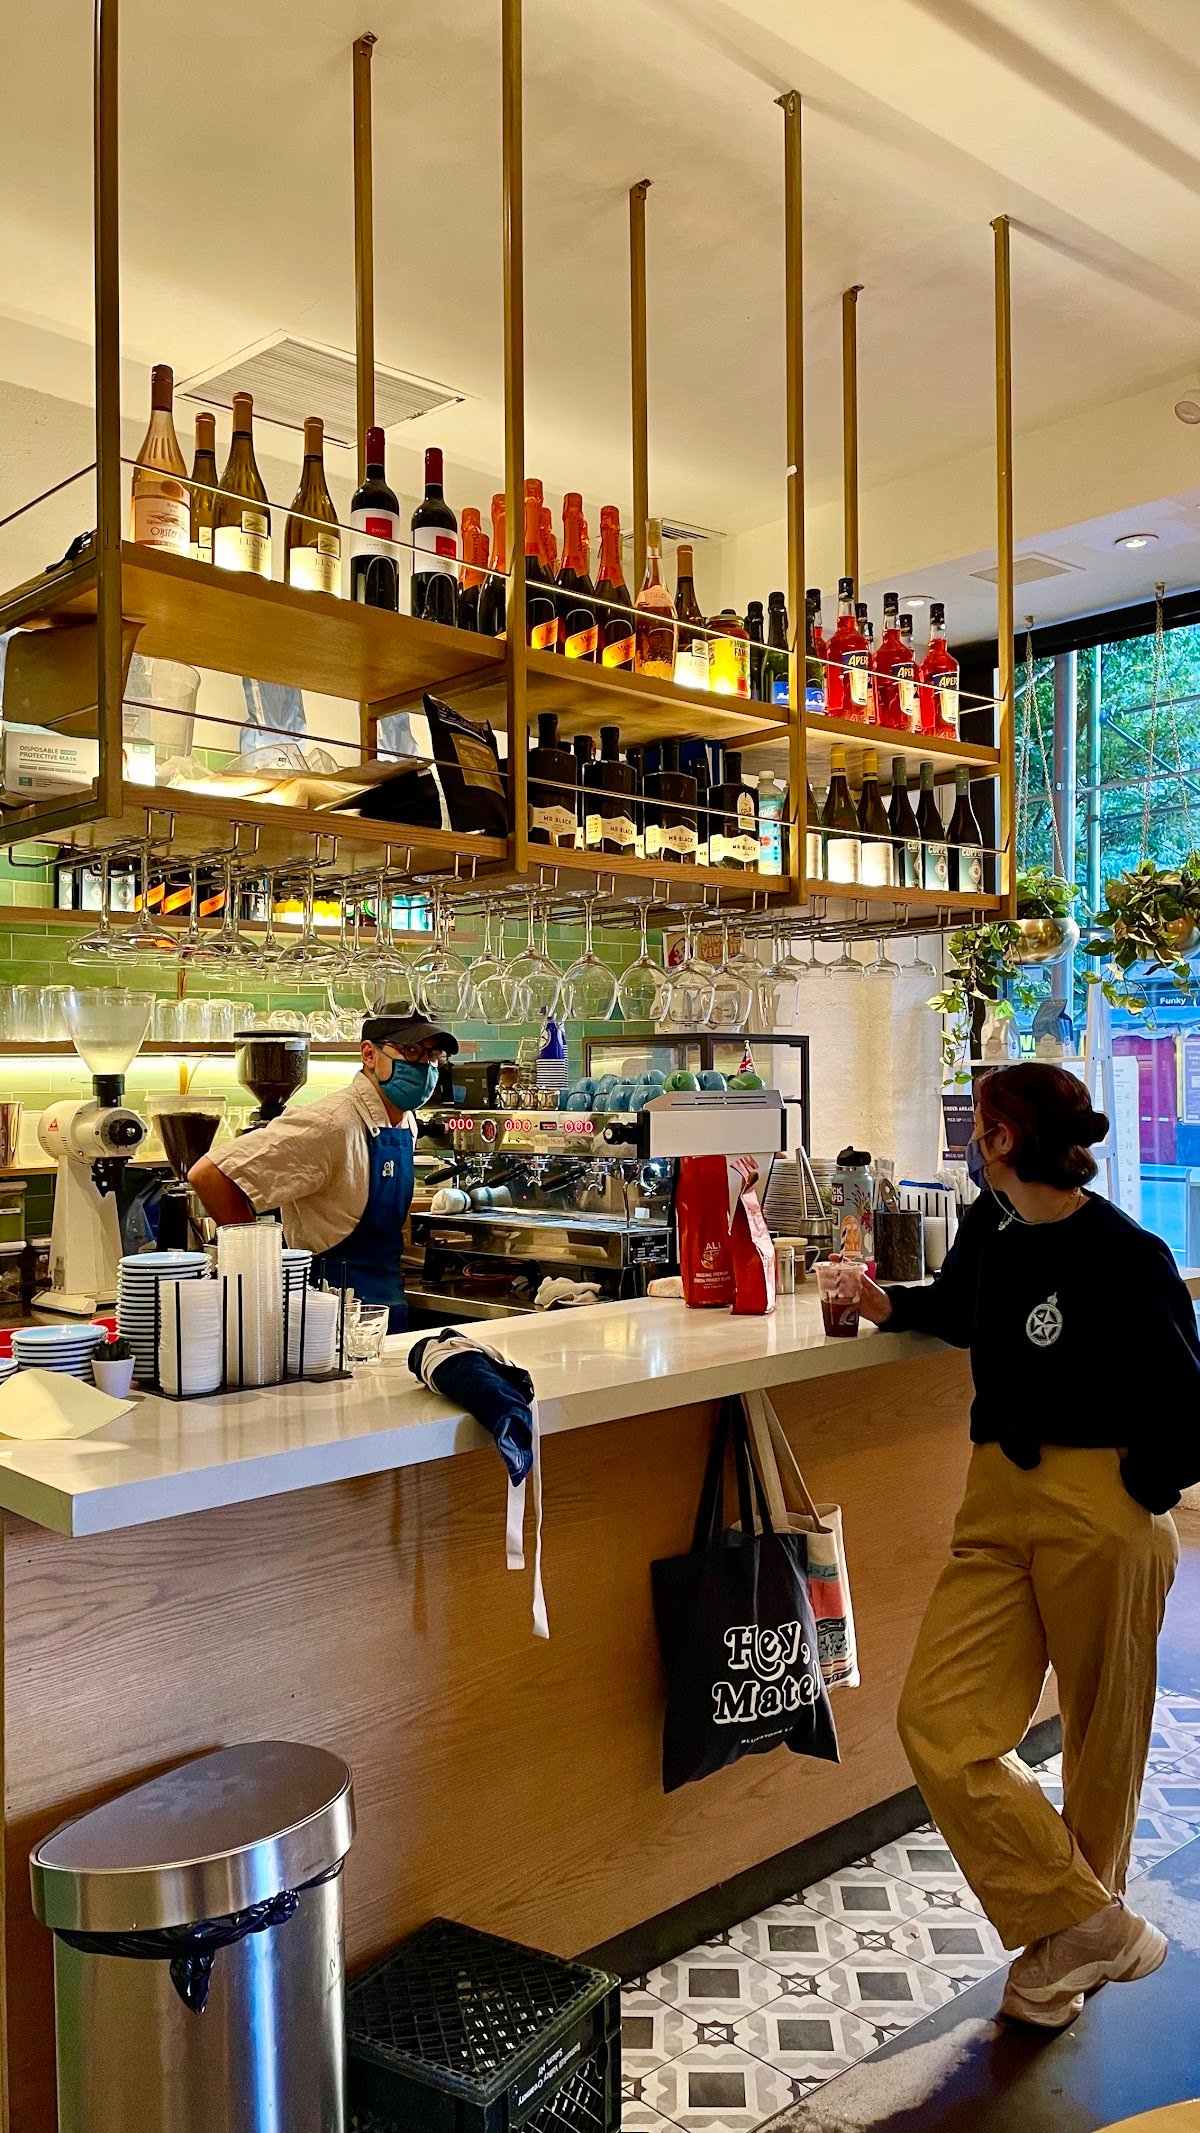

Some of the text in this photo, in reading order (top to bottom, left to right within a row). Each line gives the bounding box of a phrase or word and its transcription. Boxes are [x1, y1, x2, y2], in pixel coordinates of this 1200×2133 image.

[19, 745, 59, 754] DISPOSABLE
[19, 752, 58, 761] PROTECTIVE
[555, 817, 572, 825] BLACK
[620, 827, 633, 835] BLACK
[1160, 997, 1187, 1005] Funky
[724, 1620, 811, 1681] Hey,
[712, 1659, 820, 1724] Mate!
[537, 2063, 546, 2078] NY
[543, 2064, 560, 2083] Valley
[518, 2079, 544, 2107] Creamery
